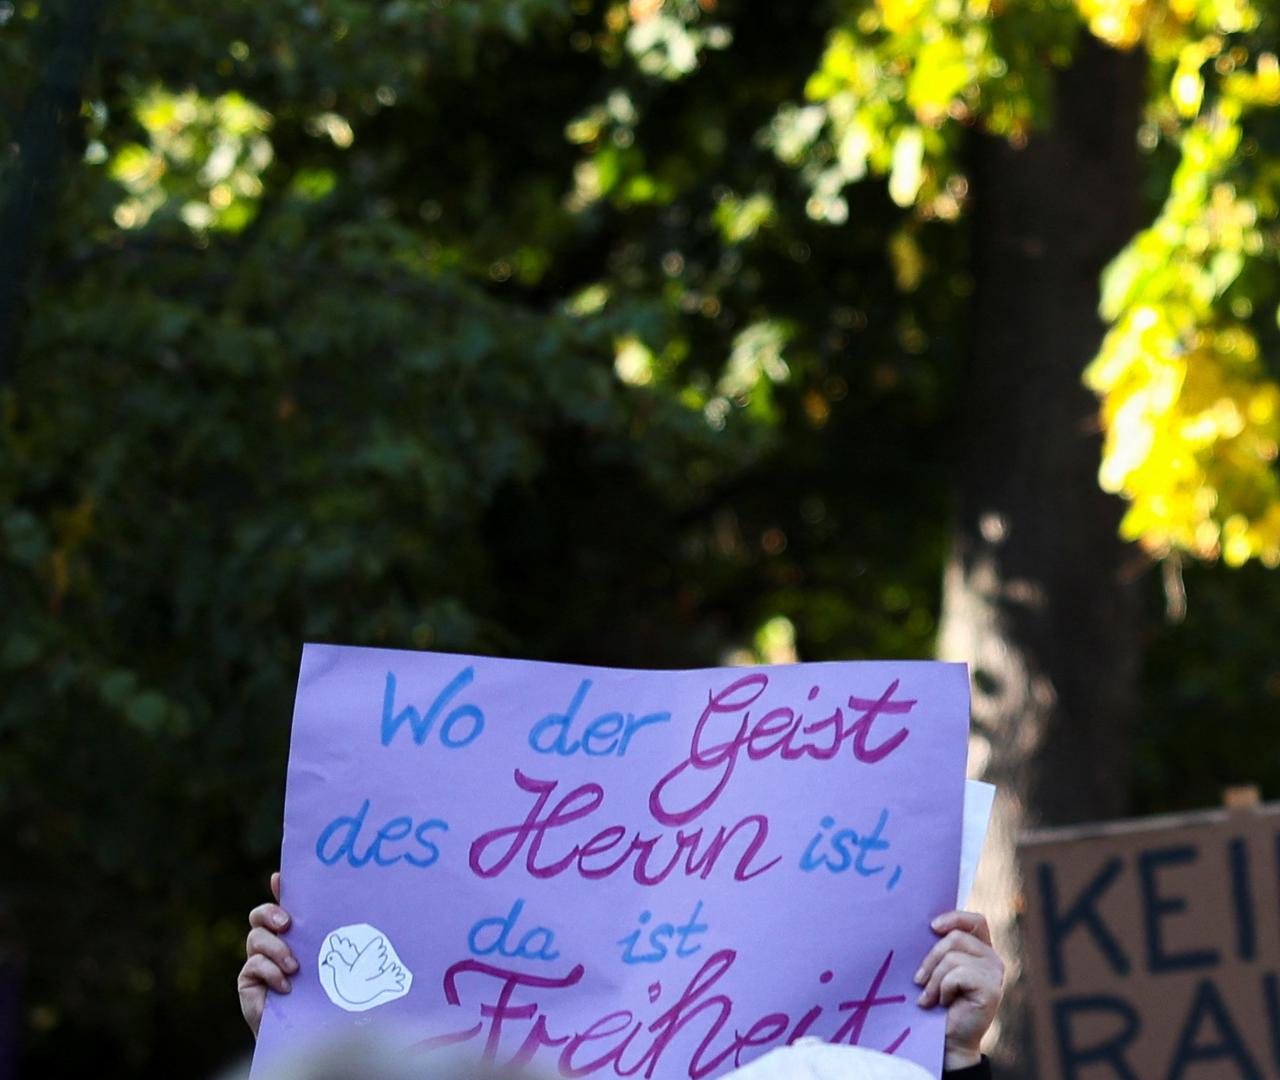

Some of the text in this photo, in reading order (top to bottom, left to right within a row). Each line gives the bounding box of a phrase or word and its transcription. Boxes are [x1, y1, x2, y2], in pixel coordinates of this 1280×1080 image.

[379, 665, 918, 826] Wo der Geist
[315, 768, 904, 892] des Herrn ist,
[467, 898, 710, 967] da ist
[405, 949, 911, 1080] Freiheit
